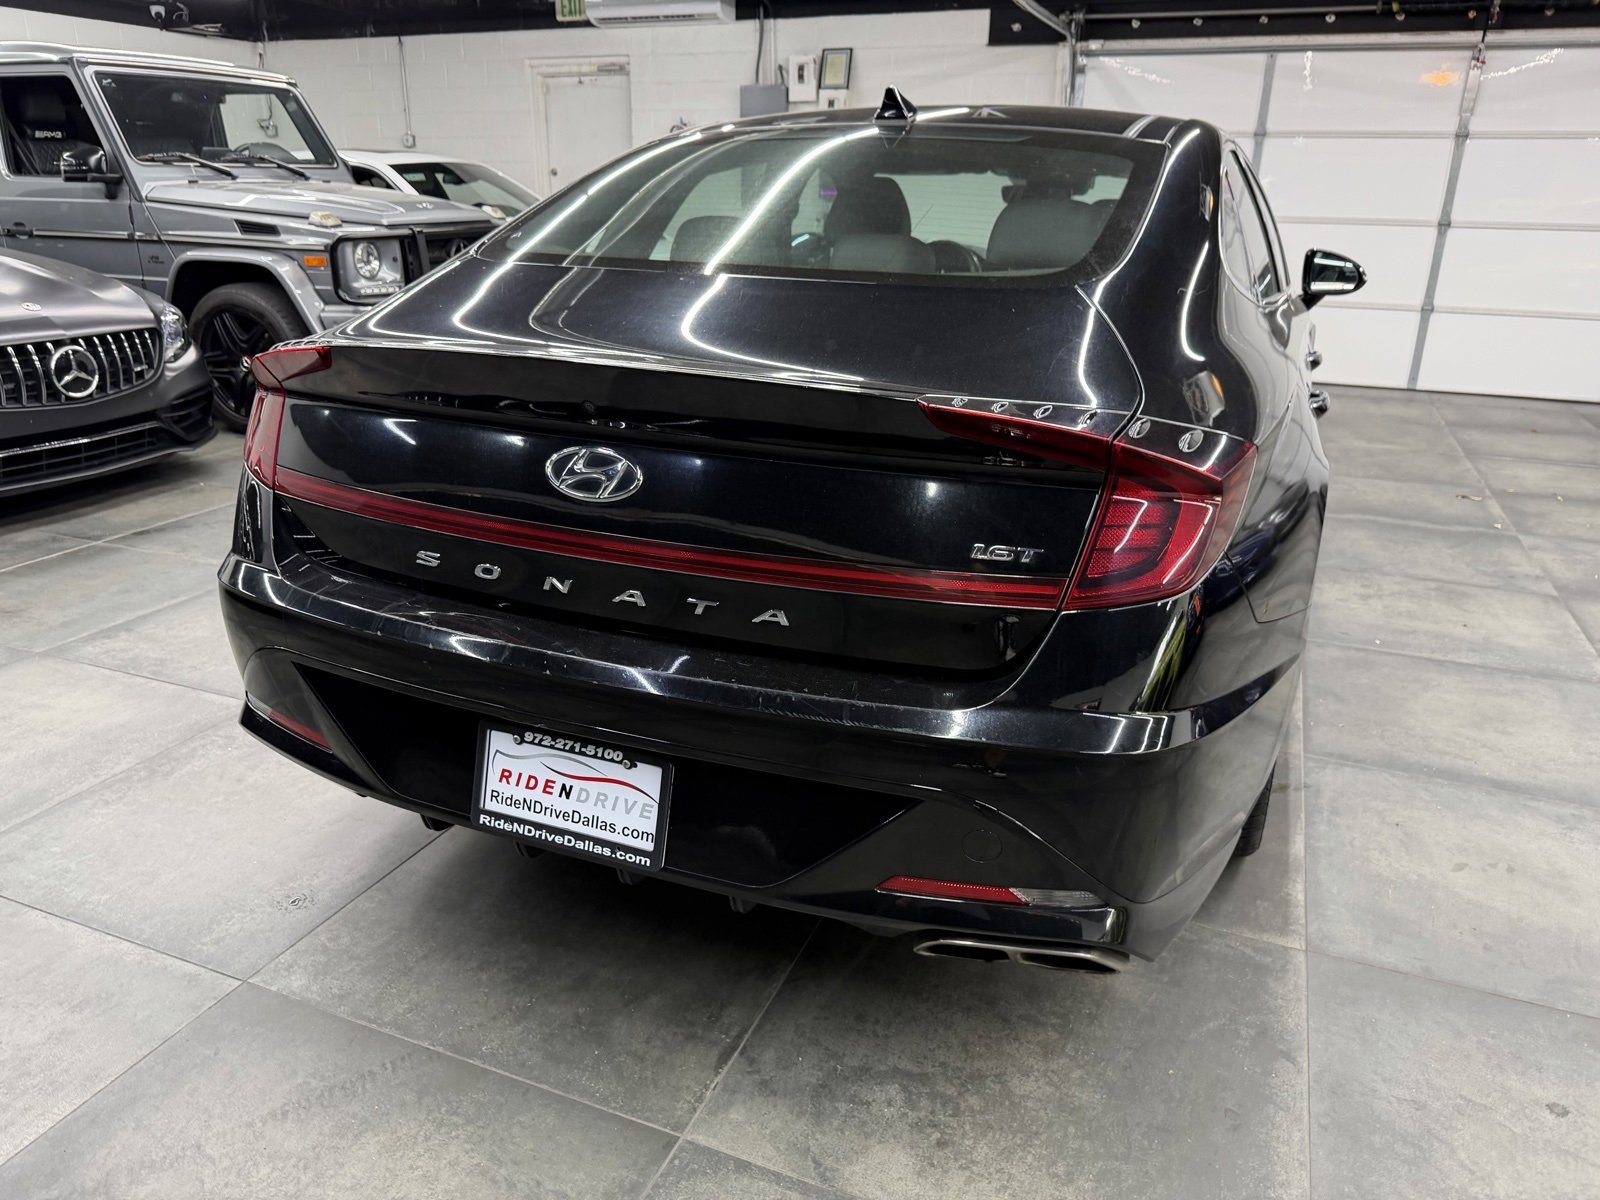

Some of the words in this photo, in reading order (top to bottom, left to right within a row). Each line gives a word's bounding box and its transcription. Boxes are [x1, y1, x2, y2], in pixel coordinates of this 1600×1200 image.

[415, 549, 790, 626] SONATA
[523, 731, 624, 762] 972-271-5100
[490, 789, 655, 843] RideNDriveDallas.com
[498, 768, 655, 820] RIDENDRIVE
[479, 814, 651, 866] RideNDriveDallas.com
